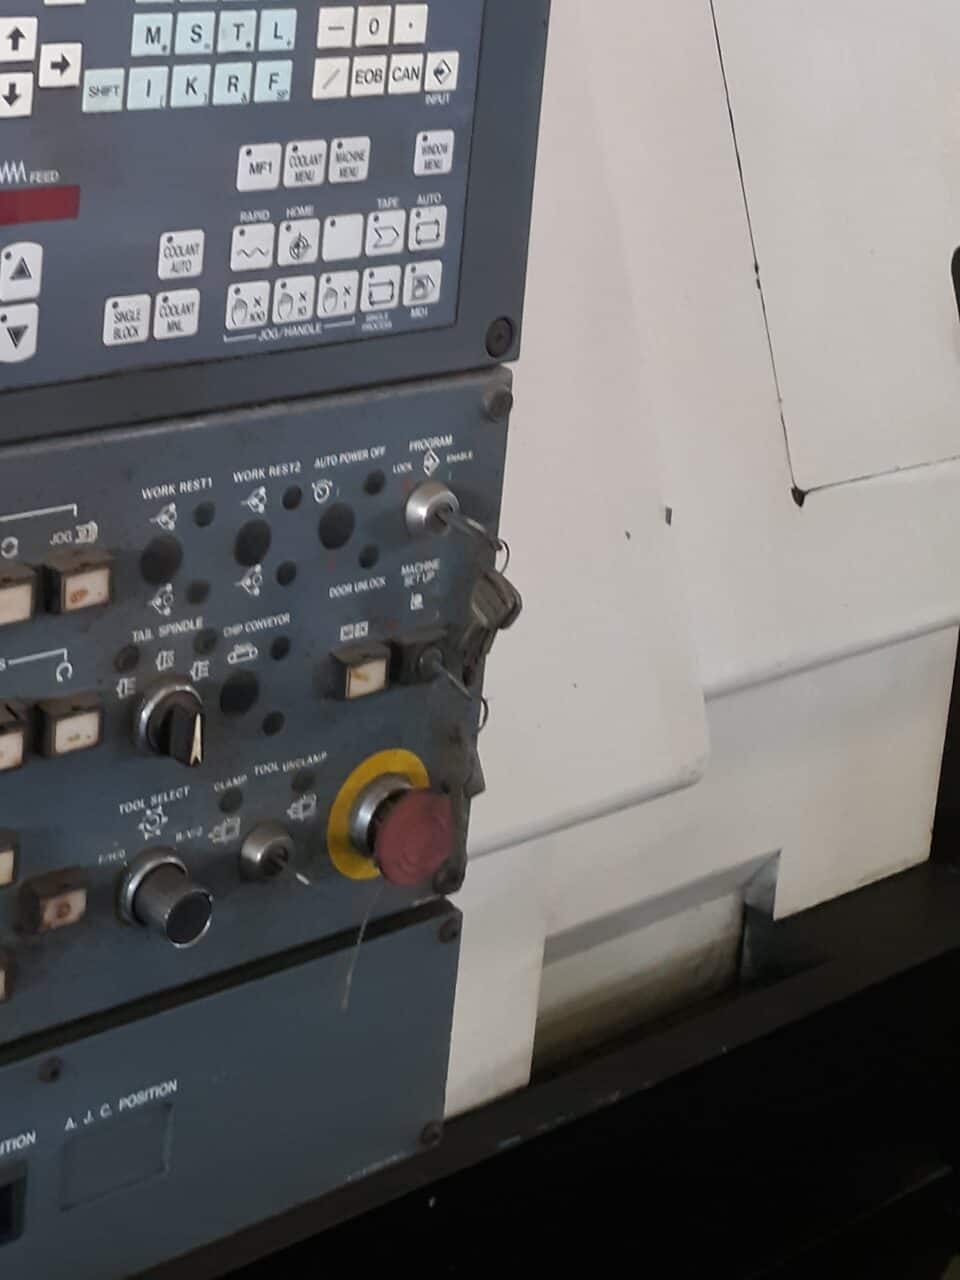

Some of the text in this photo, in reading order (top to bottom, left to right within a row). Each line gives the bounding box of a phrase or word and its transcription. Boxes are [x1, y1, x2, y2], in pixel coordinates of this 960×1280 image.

[145, 27, 160, 45] M
[190, 25, 202, 43] S
[233, 25, 243, 40] T
[273, 23, 283, 39] L
[269, 73, 279, 90] F
[355, 67, 383, 84] EOB
[392, 65, 420, 82] CAN
[89, 85, 120, 97] SHIFT
[186, 77, 198, 95] K
[228, 76, 239, 93] R
[426, 93, 450, 105] INPUT
[340, 167, 359, 178] MENU
[424, 159, 443, 170] MENU
[30, 169, 60, 183] FEED
[295, 170, 315, 182] MENU
[377, 197, 399, 208] TAPE
[417, 193, 441, 204] AUTO
[240, 210, 270, 221] RAPID
[286, 205, 314, 218] HOME
[171, 259, 192, 273] AUTO
[409, 434, 453, 452] PROGRAM
[314, 446, 386, 469] AUTO POWER OFF
[233, 461, 301, 483] WORK REST2
[393, 462, 413, 474] LOCK
[141, 478, 213, 500] WORK REST1
[49, 531, 73, 545] JOG
[329, 576, 386, 598] DOOR UNLOCK
[132, 616, 203, 643] TAIL SPINDLE
[223, 612, 290, 638] CHIP CONVEYOR
[255, 751, 328, 776] TOOL UNCLAMP
[214, 774, 247, 792] CLAMP
[119, 785, 190, 815] TOOL SELECT
[118, 1079, 178, 1112] POSITION
